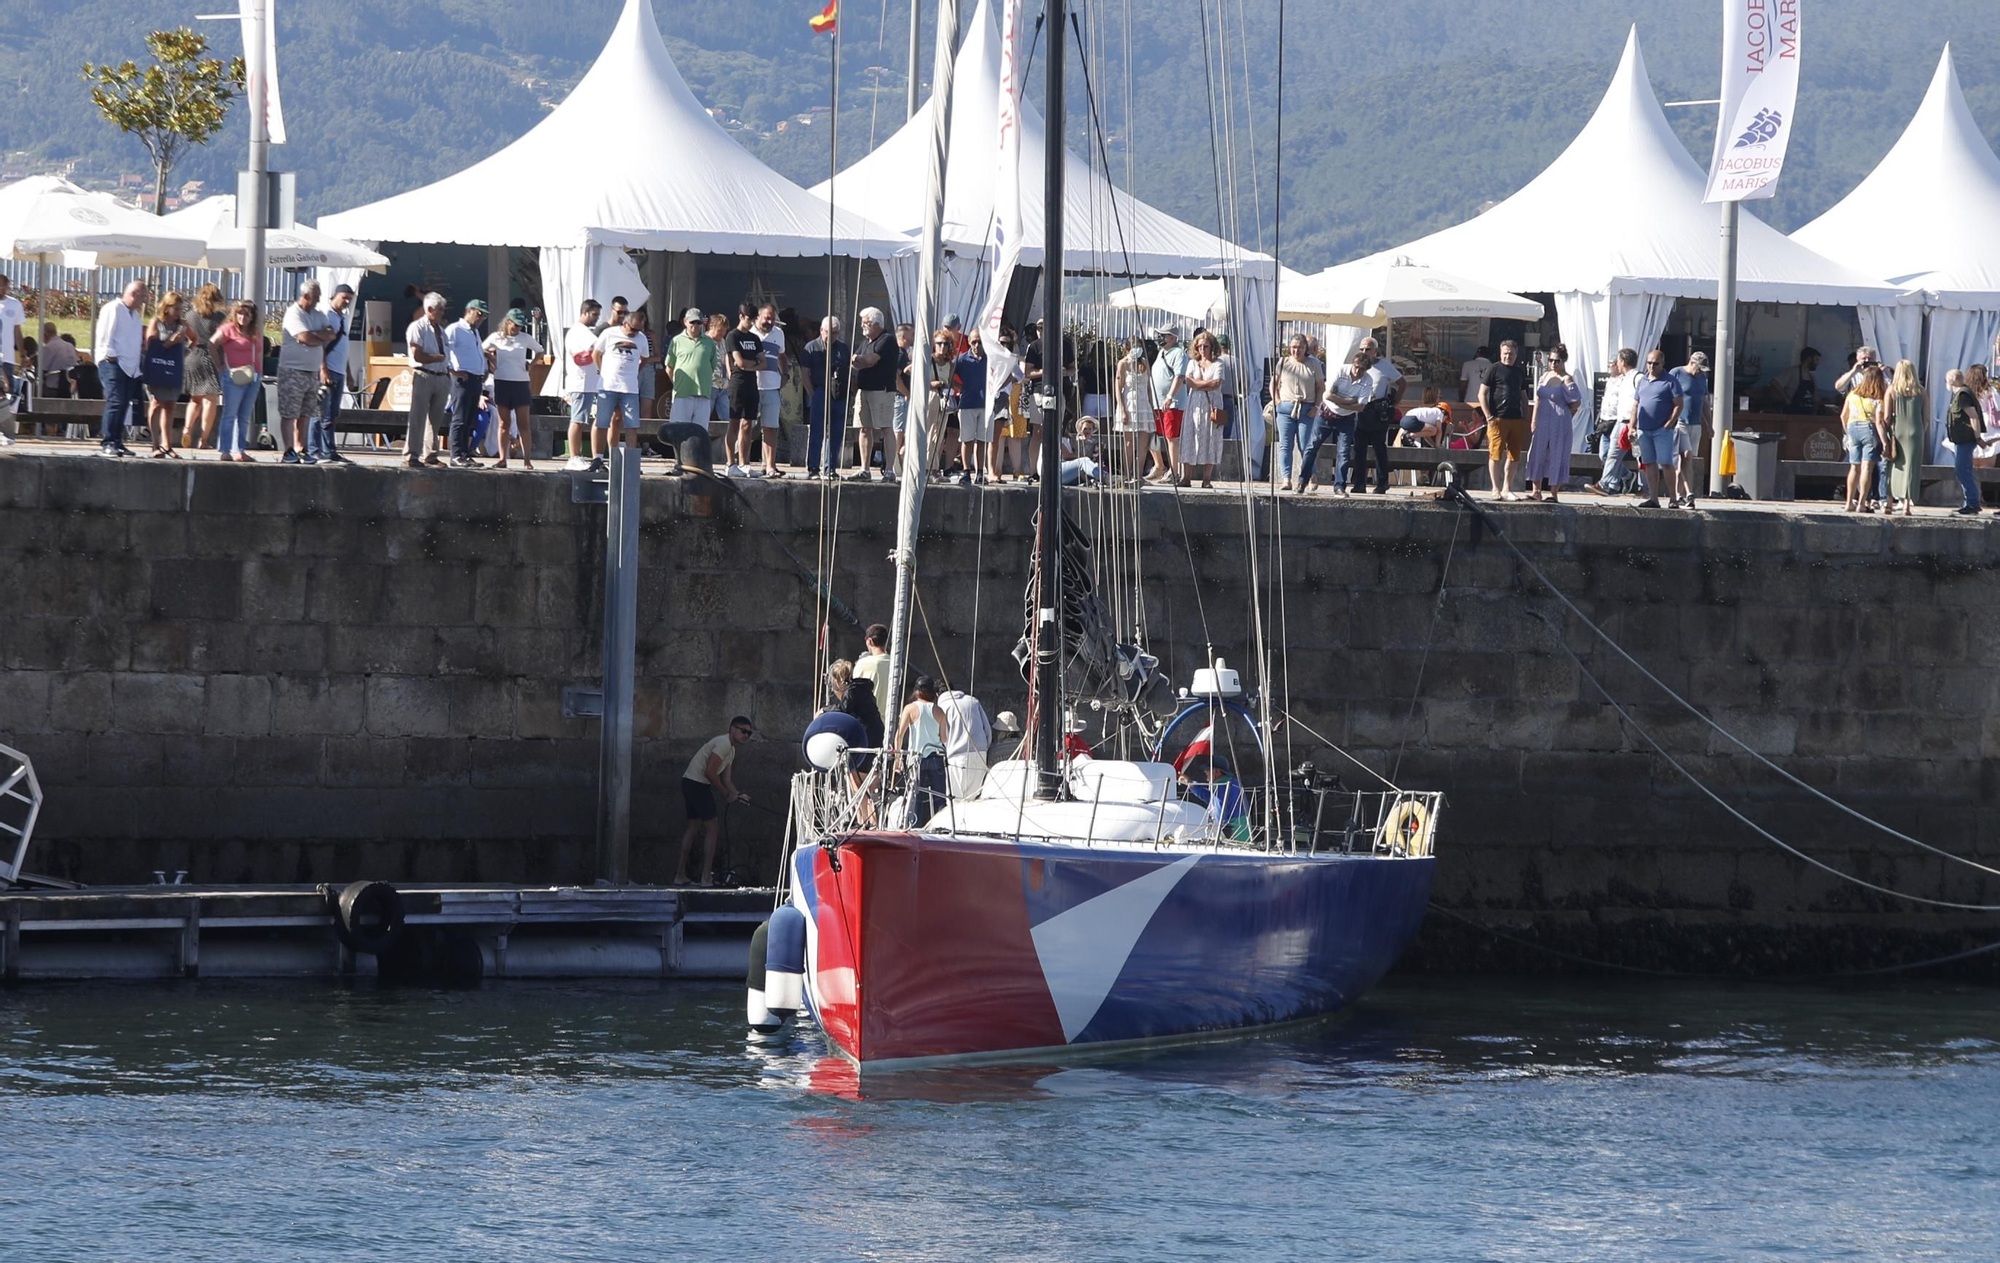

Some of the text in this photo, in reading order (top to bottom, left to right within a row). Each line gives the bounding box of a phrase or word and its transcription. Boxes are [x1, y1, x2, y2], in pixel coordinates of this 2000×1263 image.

[1719, 157, 1782, 171] IACOBUS
[1721, 177, 1768, 191] MARIS
[739, 340, 757, 351] VANS
